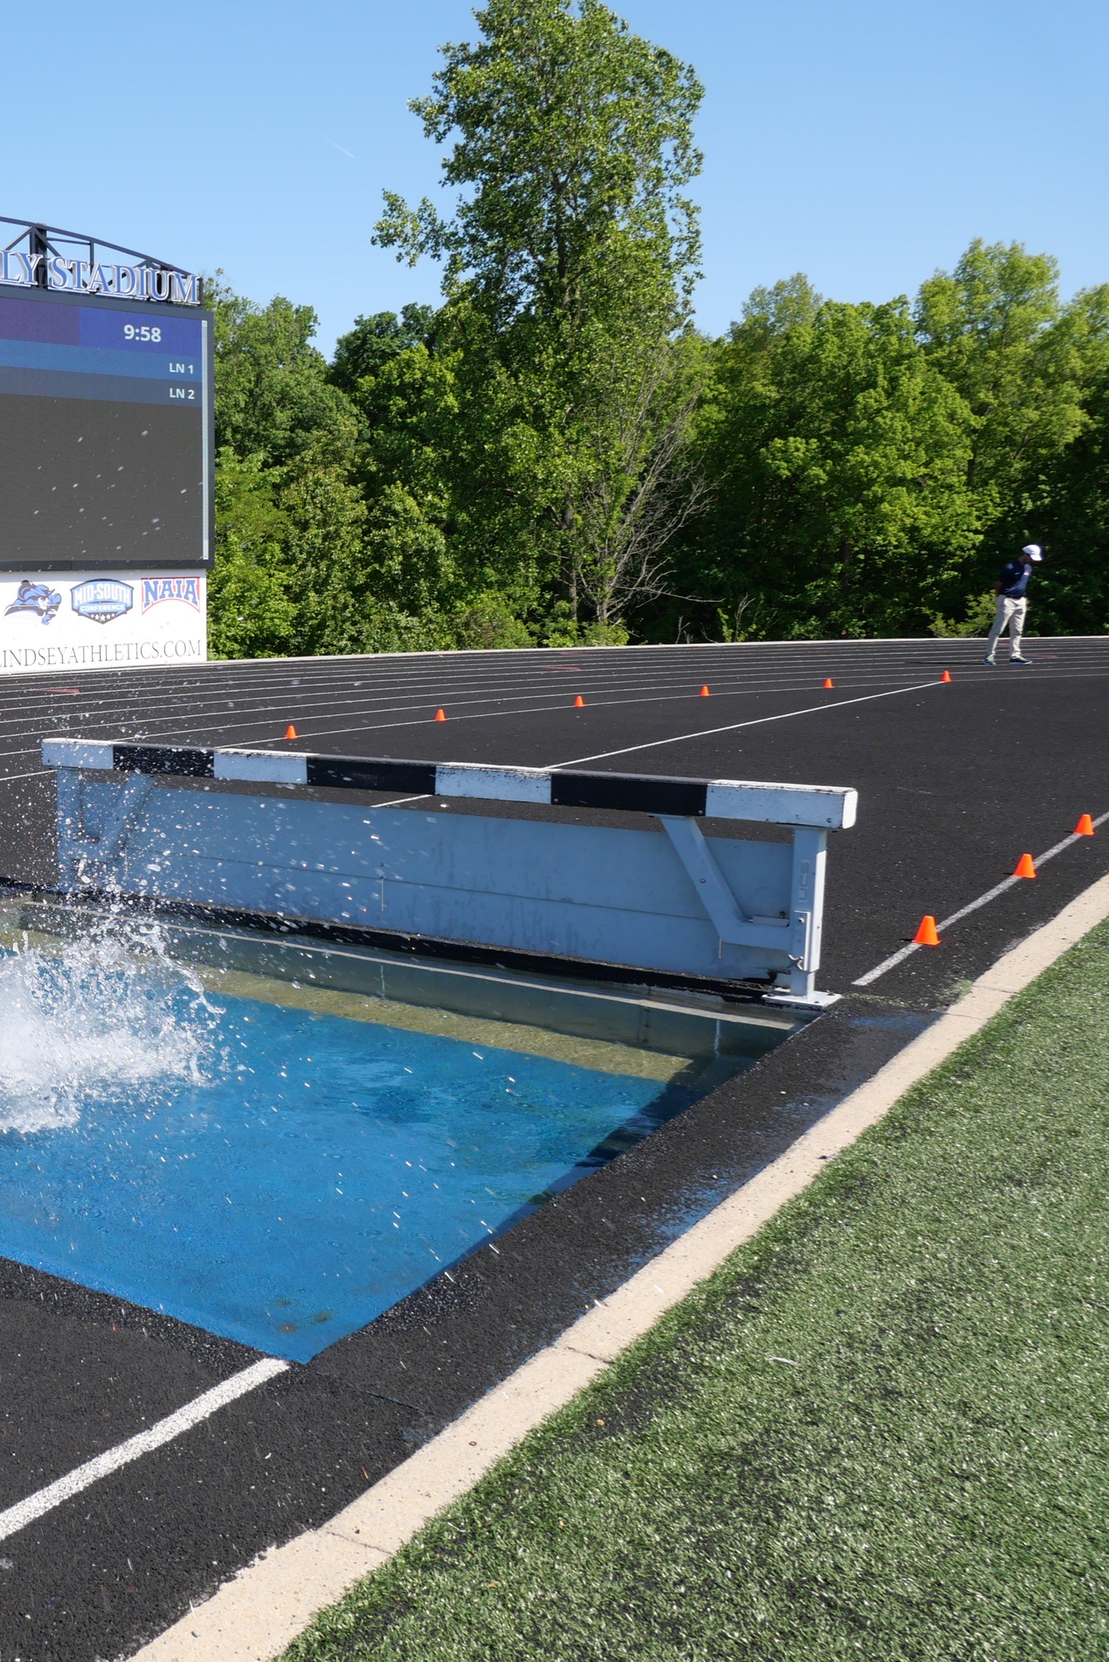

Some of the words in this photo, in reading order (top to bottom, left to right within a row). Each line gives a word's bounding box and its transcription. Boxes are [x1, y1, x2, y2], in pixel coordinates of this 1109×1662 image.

[48, 257, 200, 305] STADIUM
[123, 324, 162, 342] 9:58
[169, 362, 185, 374] LN
[188, 365, 194, 374] 1
[169, 388, 185, 399] LN
[188, 389, 195, 399] 2
[74, 582, 131, 606] MID-SOUTH
[144, 579, 198, 609] NAIA
[80, 604, 125, 612] CONFERENCE
